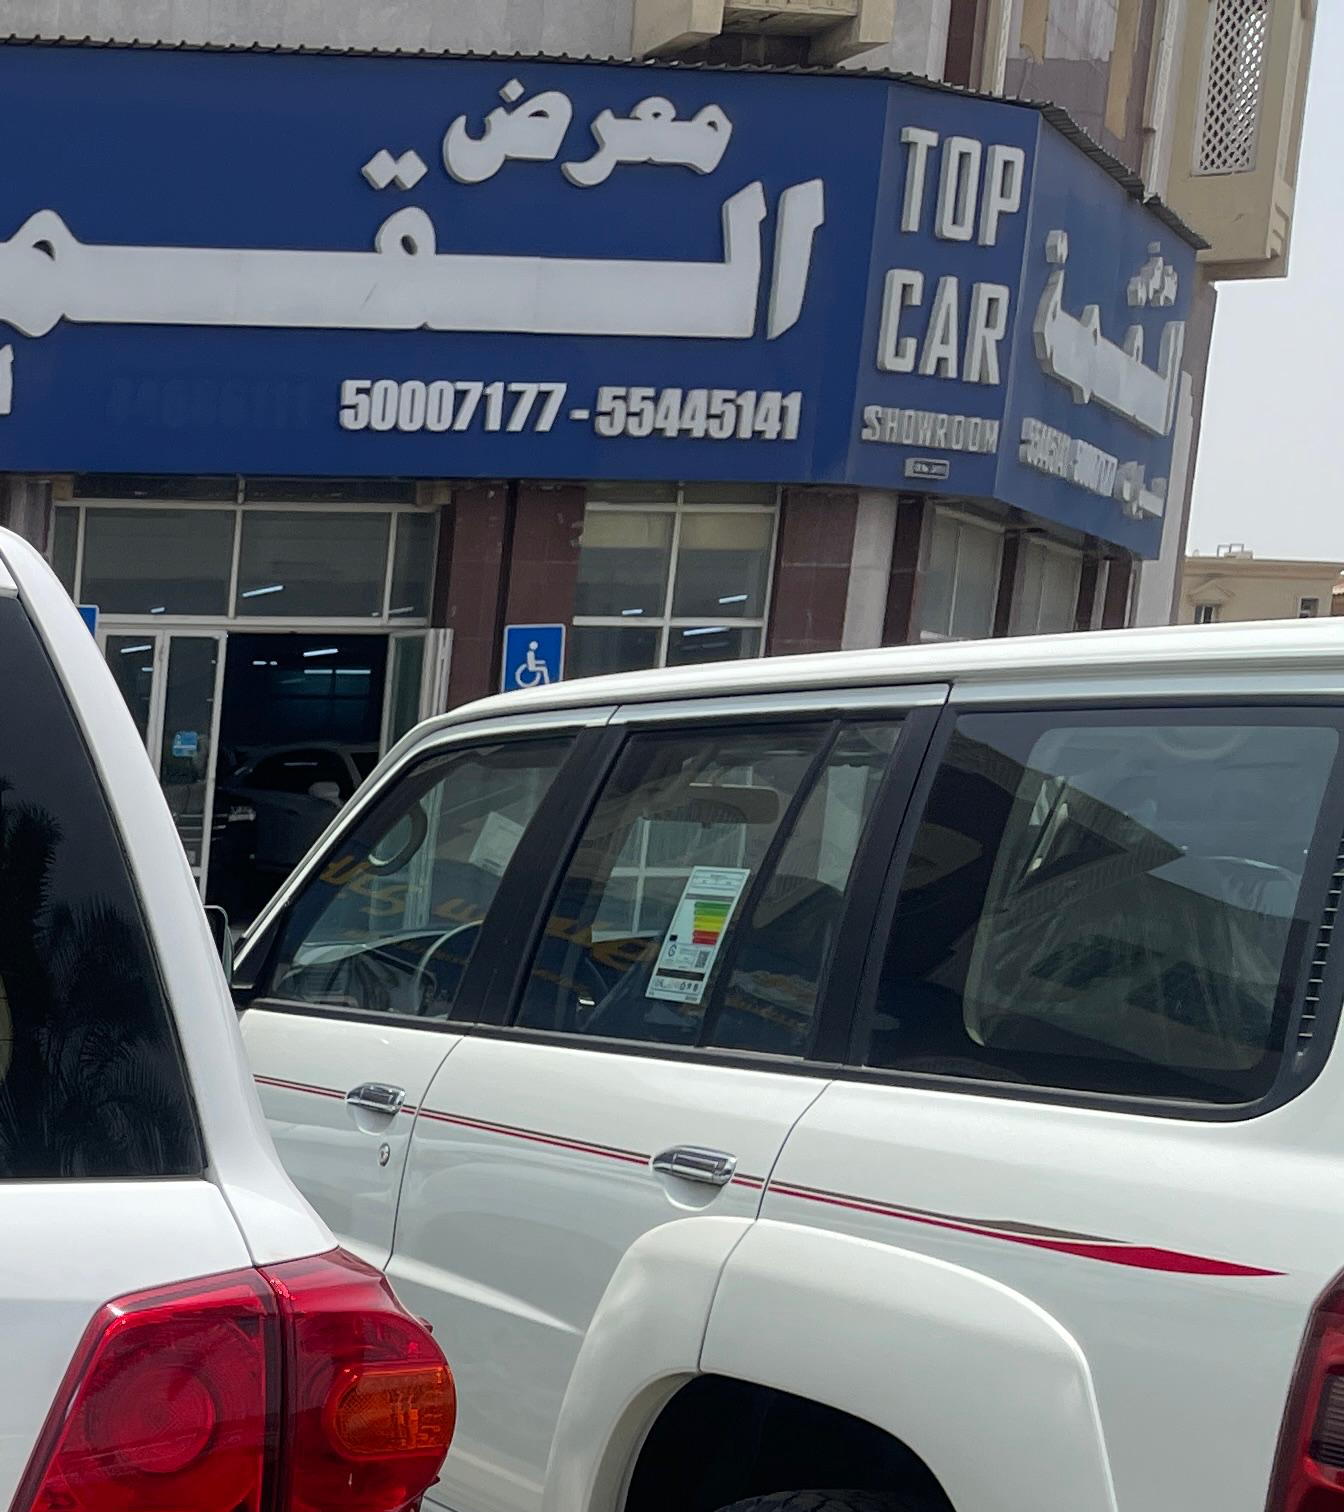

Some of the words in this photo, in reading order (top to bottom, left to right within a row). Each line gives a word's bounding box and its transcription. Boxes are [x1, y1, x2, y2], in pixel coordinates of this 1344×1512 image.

[442, 77, 733, 188] معرض
[901, 126, 1025, 246] TOP
[877, 269, 1009, 385] CAR
[862, 405, 999, 453] SHOWROOM
